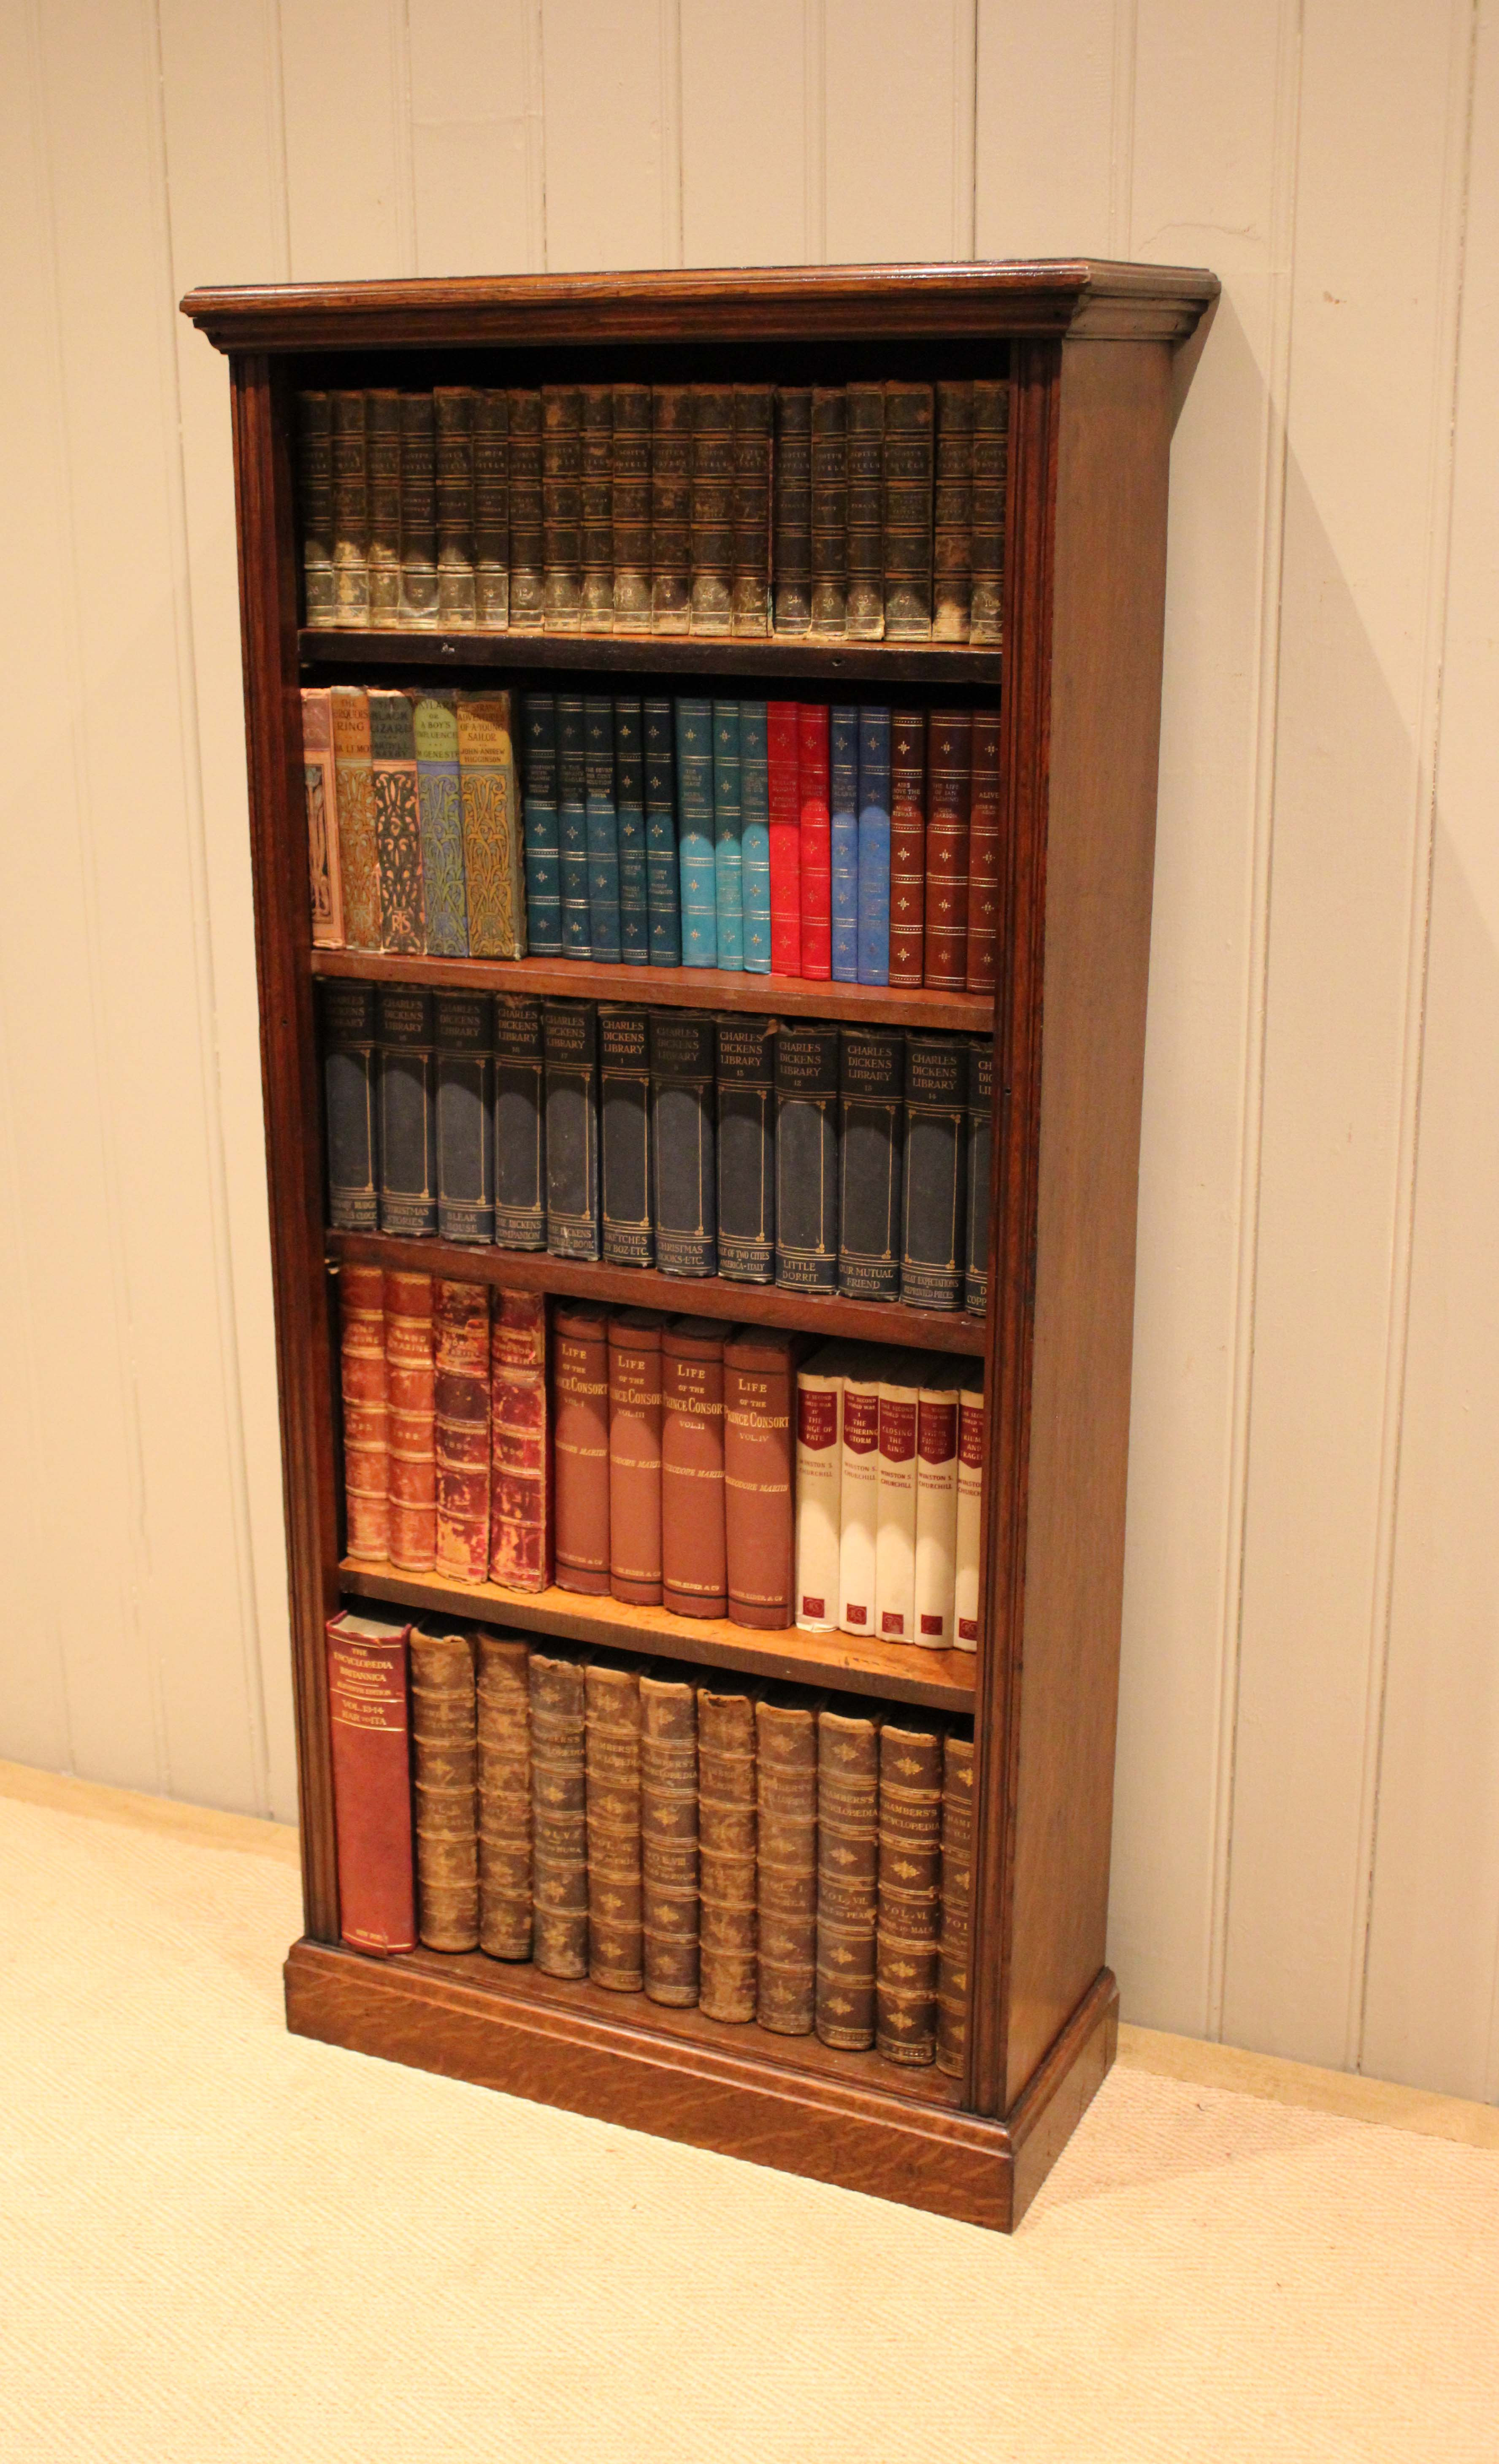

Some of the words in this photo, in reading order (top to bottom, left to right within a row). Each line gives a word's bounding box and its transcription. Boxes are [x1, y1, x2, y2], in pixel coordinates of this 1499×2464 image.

[337, 721, 364, 731] RING
[428, 721, 451, 729] BOY'S
[467, 732, 497, 742] SAILOR
[383, 998, 423, 1009] CHARLES
[384, 1010, 423, 1020] DICKENS
[498, 1008, 538, 1019] CHARLES
[440, 1014, 480, 1025] DICKENS
[498, 1019, 538, 1031] DICKENS
[546, 1015, 585, 1027] CHARLES
[603, 1020, 644, 1030] CHARLES
[384, 1021, 422, 1032] LIBRARY
[547, 1026, 585, 1037] DICKENS
[498, 1031, 538, 1045] LIBRARY
[603, 1031, 645, 1042] DICKENS
[656, 1027, 699, 1038] CHARLES
[720, 1031, 763, 1043] CHARLES
[547, 1037, 585, 1050] LIBRARY
[603, 1043, 645, 1054] LIBRARY
[657, 1039, 699, 1050] DICKENS
[720, 1042, 763, 1054] DICKENS
[779, 1041, 821, 1052] CHARLES
[847, 1045, 893, 1056] CHARLES
[720, 1054, 763, 1067] LIBRARY
[779, 1053, 822, 1064] DICKENS
[848, 1056, 893, 1069] DICKENS
[912, 1054, 957, 1065] CHARLES
[779, 1064, 822, 1077] LIBRARY
[848, 1069, 893, 1081] LIBRARY
[912, 1065, 958, 1078] DICKENS
[912, 1077, 958, 1090] LIBRARY
[384, 1205, 430, 1216] CHRISTMAS
[387, 1215, 424, 1226] STORIES
[447, 1212, 477, 1222] BLEAK
[447, 1223, 478, 1233] HOUSE
[509, 1219, 542, 1229] DICKENS
[605, 1232, 648, 1246] SKETCHES
[658, 1241, 704, 1255] CHRISTMAS
[728, 1249, 735, 1257] OF
[736, 1250, 750, 1259] TWO
[750, 1251, 770, 1261] CITIES
[783, 1259, 816, 1272] LITTLE
[839, 1264, 854, 1275] OUR
[855, 1267, 893, 1278] MUTUAL
[782, 1270, 819, 1283] DORRIT
[917, 1276, 959, 1288] EXPECTATIONS
[847, 1277, 881, 1290] FRIEND
[934, 1291, 955, 1299] PIECES
[571, 1366, 587, 1374] THE
[689, 1386, 705, 1394] THE
[725, 1405, 749, 1427] PRINCE
[750, 1412, 789, 1429] CONSORT
[808, 1416, 823, 1424] THE
[853, 1418, 867, 1427] THE
[844, 1424, 879, 1436] GATHERING
[882, 1426, 912, 1437] CLOSING
[806, 1434, 825, 1442] FATE
[850, 1435, 872, 1444] STORM
[889, 1436, 902, 1444] THE
[887, 1444, 905, 1454] RING
[967, 1444, 982, 1452] AND
[844, 1461, 871, 1472] WINSTON
[844, 1469, 876, 1481] CHURCHILL
[880, 1470, 906, 1479] WINSTON
[918, 1472, 946, 1481] WINSTON
[759, 1483, 788, 1492] MARTIN
[880, 1478, 912, 1489] CHURCHILL
[918, 1481, 953, 1490] CHURCHILL
[352, 1647, 368, 1657] THE
[338, 1665, 387, 1682] BRITANNICA
[370, 1716, 387, 1726] ITA
